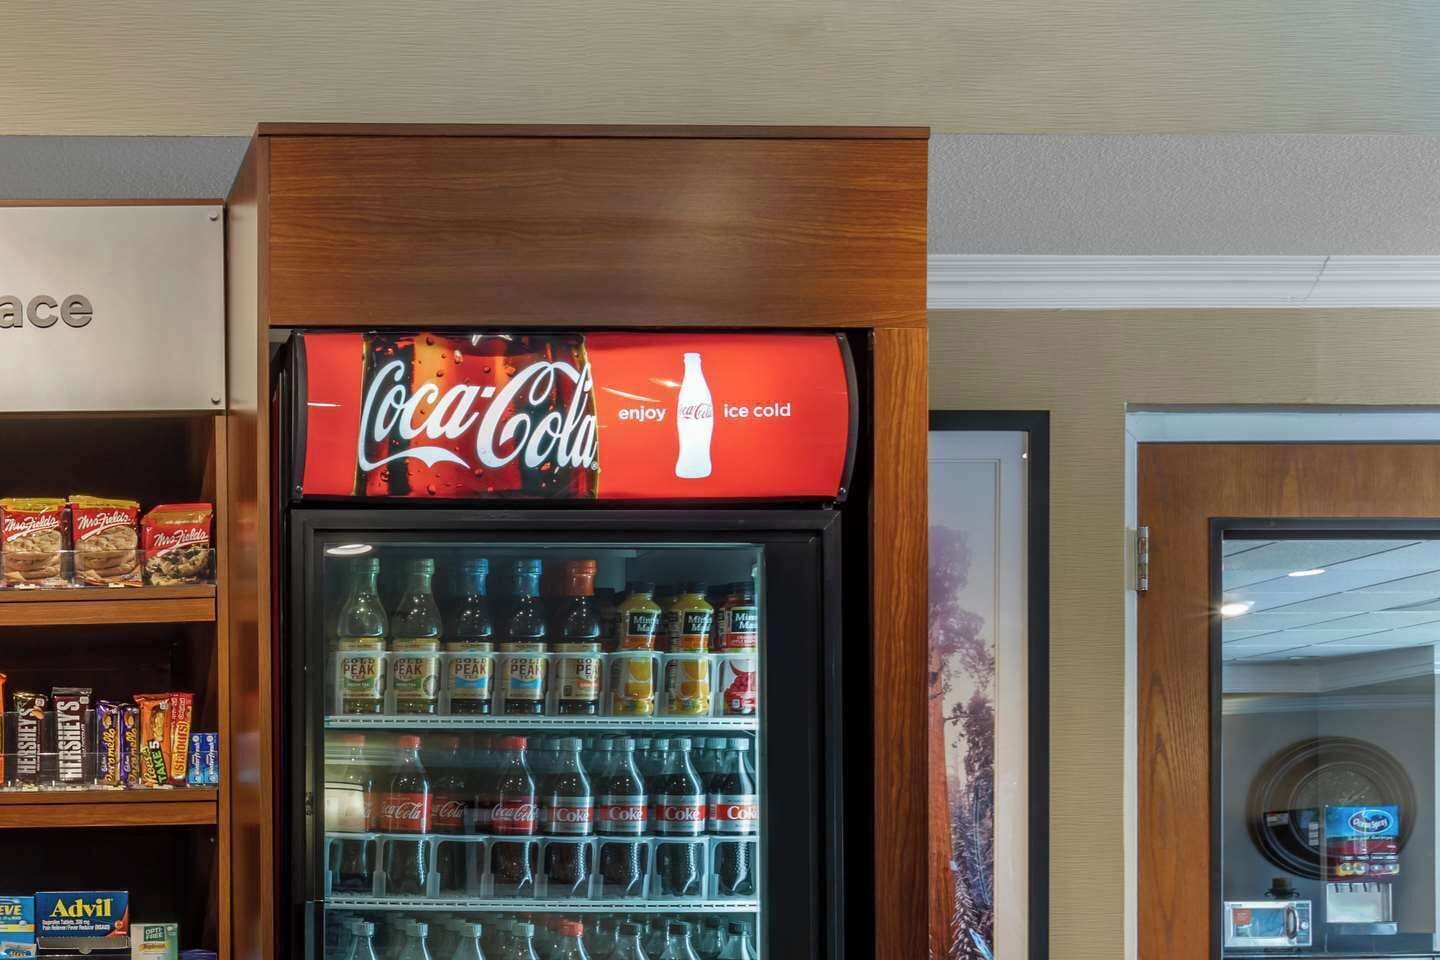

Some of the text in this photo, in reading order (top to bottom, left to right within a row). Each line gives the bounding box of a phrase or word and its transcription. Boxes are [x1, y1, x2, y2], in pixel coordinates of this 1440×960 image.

[358, 359, 598, 472] Coca-Cola
[618, 404, 667, 422] enjoy
[724, 403, 791, 418] ice cold
[344, 663, 375, 675] PEAK
[394, 663, 423, 675] PEAK
[455, 663, 487, 675] PEAK
[17, 707, 37, 774] HERSHEY'S
[57, 701, 82, 779] HERSHEY'S
[149, 741, 168, 784] TAKE 5
[557, 807, 589, 822] Coke
[609, 806, 644, 820] Coke
[664, 806, 700, 820] Coke
[49, 898, 113, 918] Advil
